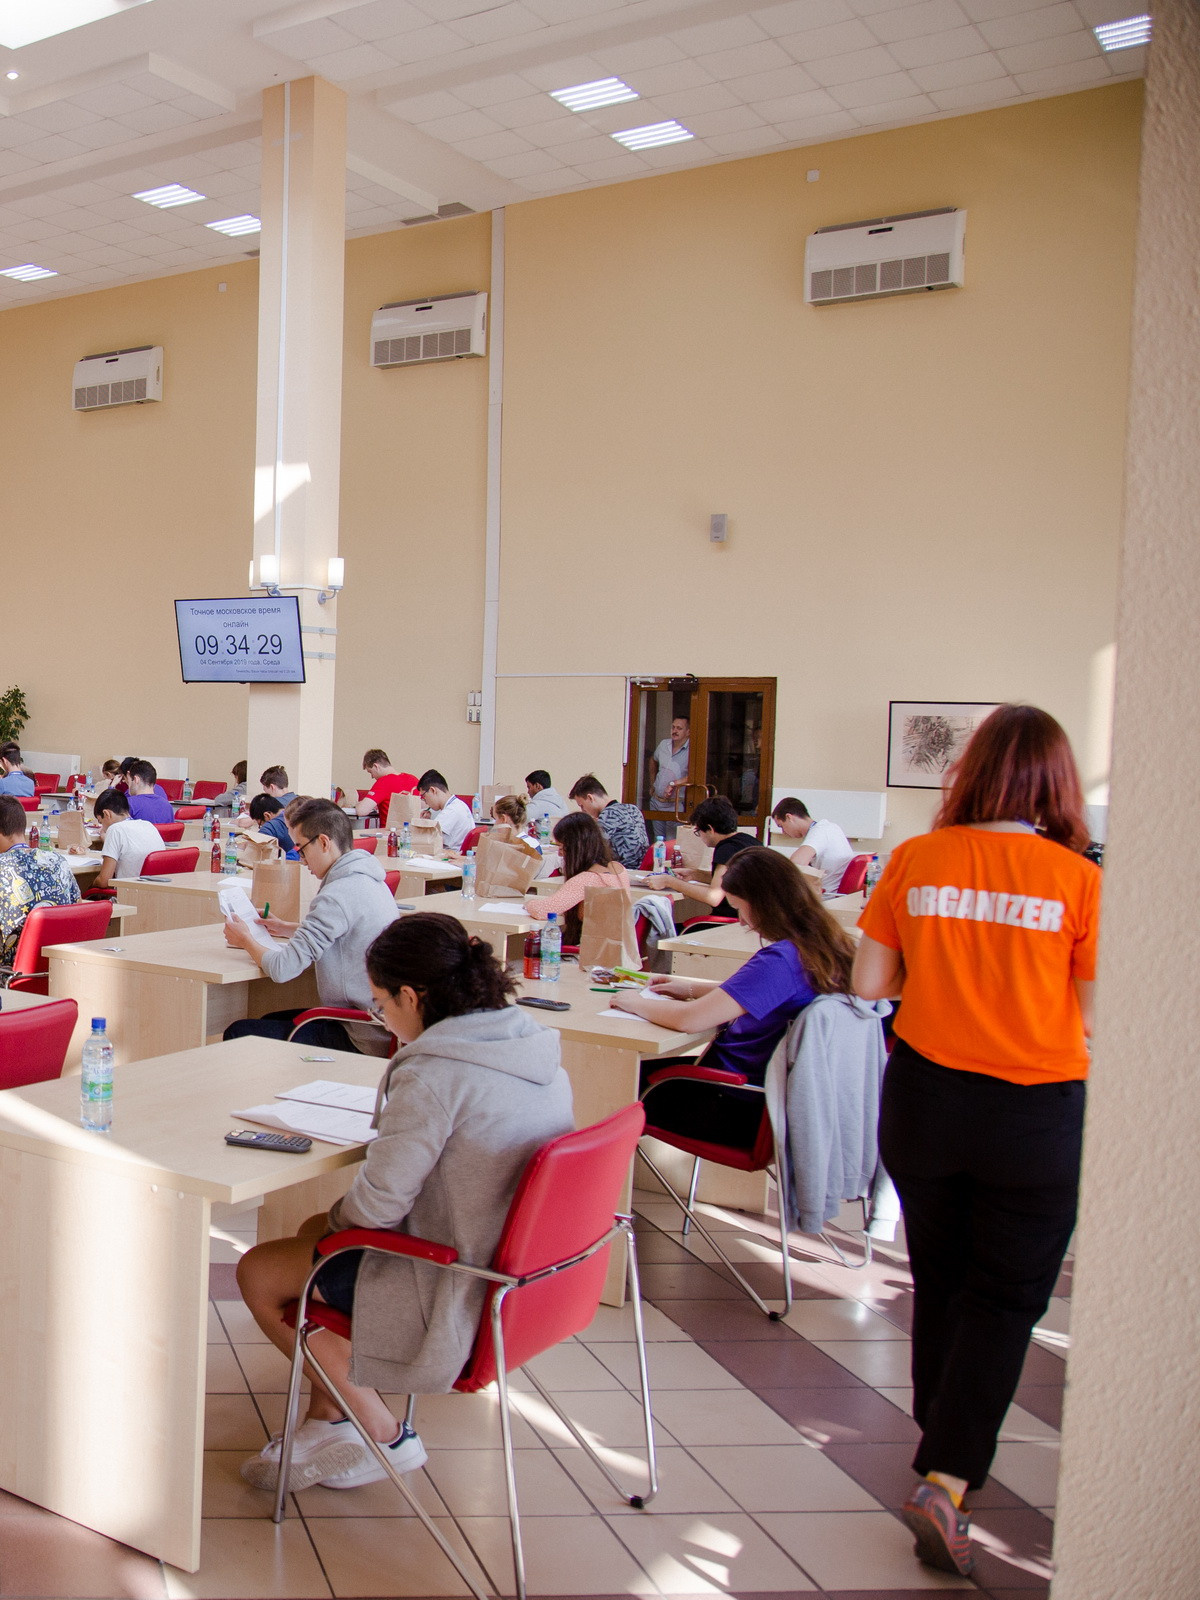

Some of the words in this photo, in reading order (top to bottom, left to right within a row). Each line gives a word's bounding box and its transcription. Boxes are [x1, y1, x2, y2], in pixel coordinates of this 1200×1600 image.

[190, 608, 215, 616] Точное
[216, 607, 257, 616] московское
[258, 606, 282, 616] время
[222, 620, 249, 628] онлайн
[906, 885, 1065, 933] ORGANIZER
